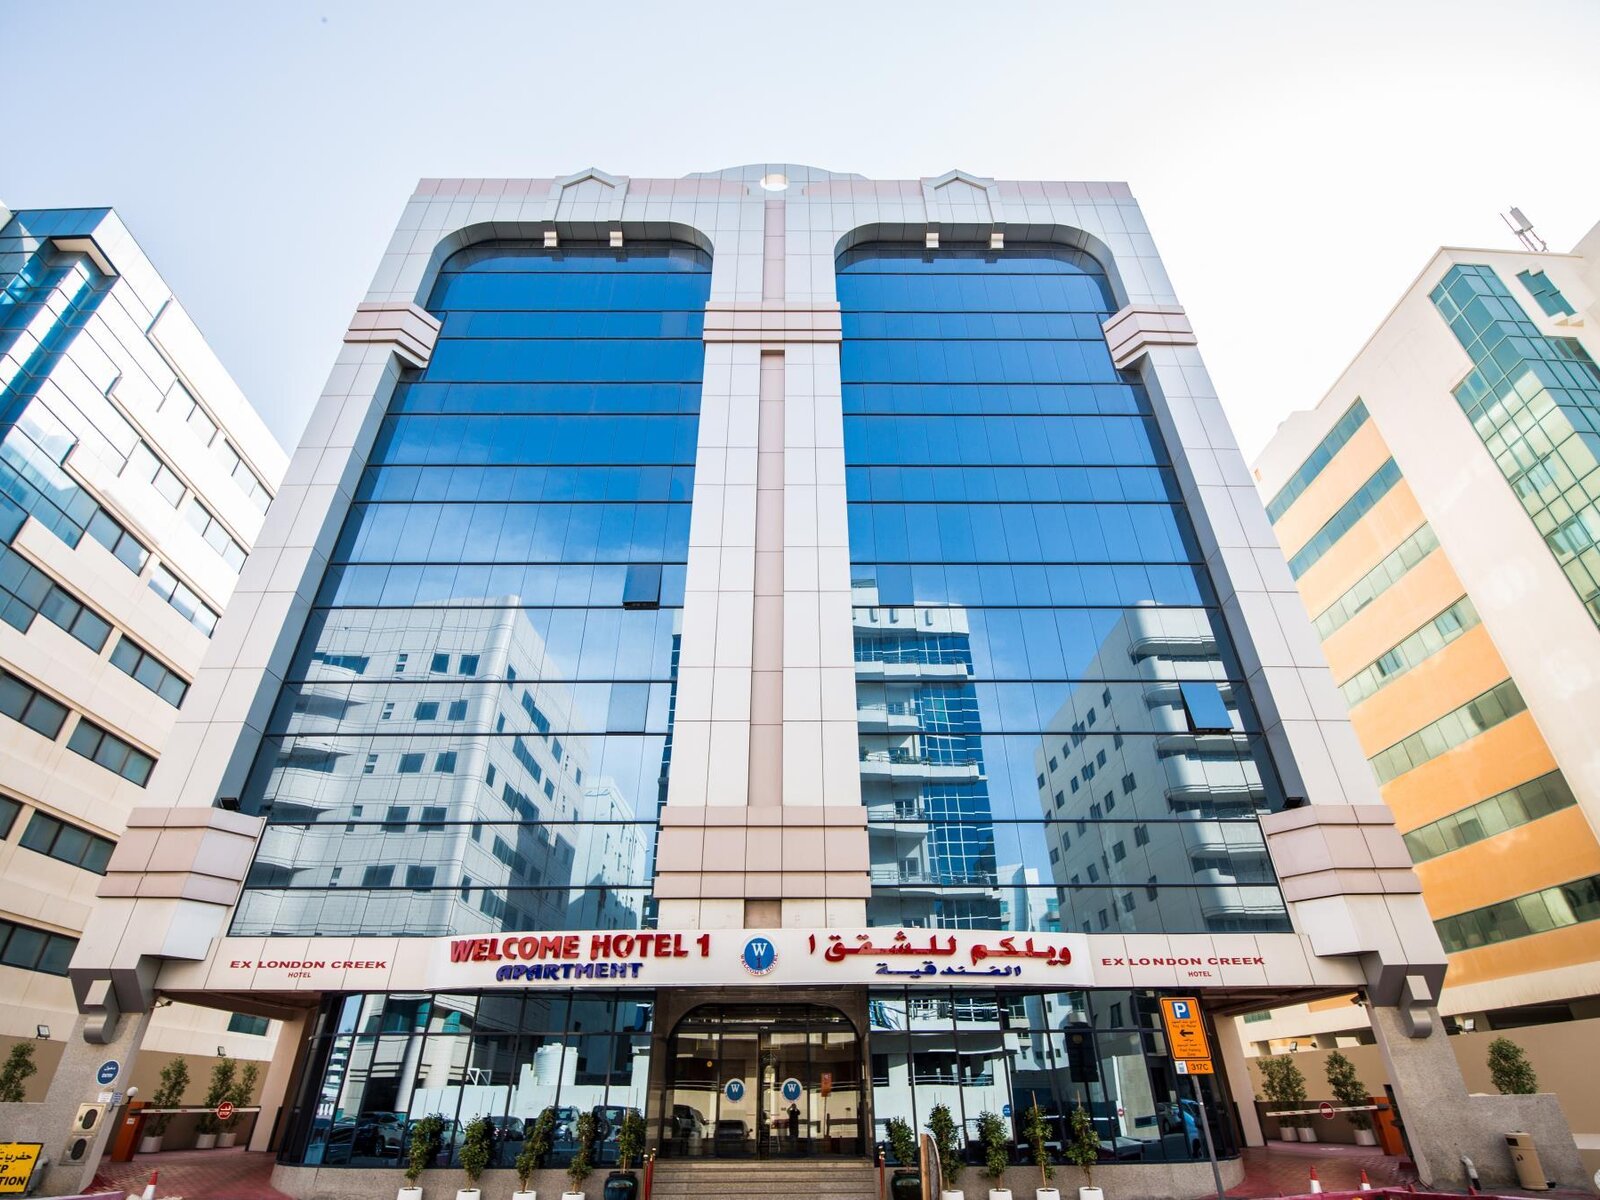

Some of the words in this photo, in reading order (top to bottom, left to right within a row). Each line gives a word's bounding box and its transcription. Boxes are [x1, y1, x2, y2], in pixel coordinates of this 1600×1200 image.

[450, 934, 581, 963] WELCOME
[590, 933, 689, 961] HOTEL
[696, 933, 710, 958] 1
[750, 942, 768, 957] W
[824, 930, 958, 962] للشقق
[970, 936, 1072, 967] ويلكم
[229, 960, 253, 969] EX
[257, 960, 326, 969] LONDON
[330, 960, 388, 969] CREEK
[740, 954, 764, 975] WELCOME
[875, 960, 1022, 978] الفندقية
[1101, 958, 1125, 966] EX
[1128, 957, 1202, 966] LONDON
[1207, 957, 1265, 965] CREEK
[495, 962, 644, 982] APARTMENT
[1173, 1002, 1187, 1018] P
[1190, 1063, 1209, 1071] 317C
[731, 1083, 740, 1093] W
[787, 1083, 797, 1093] W
